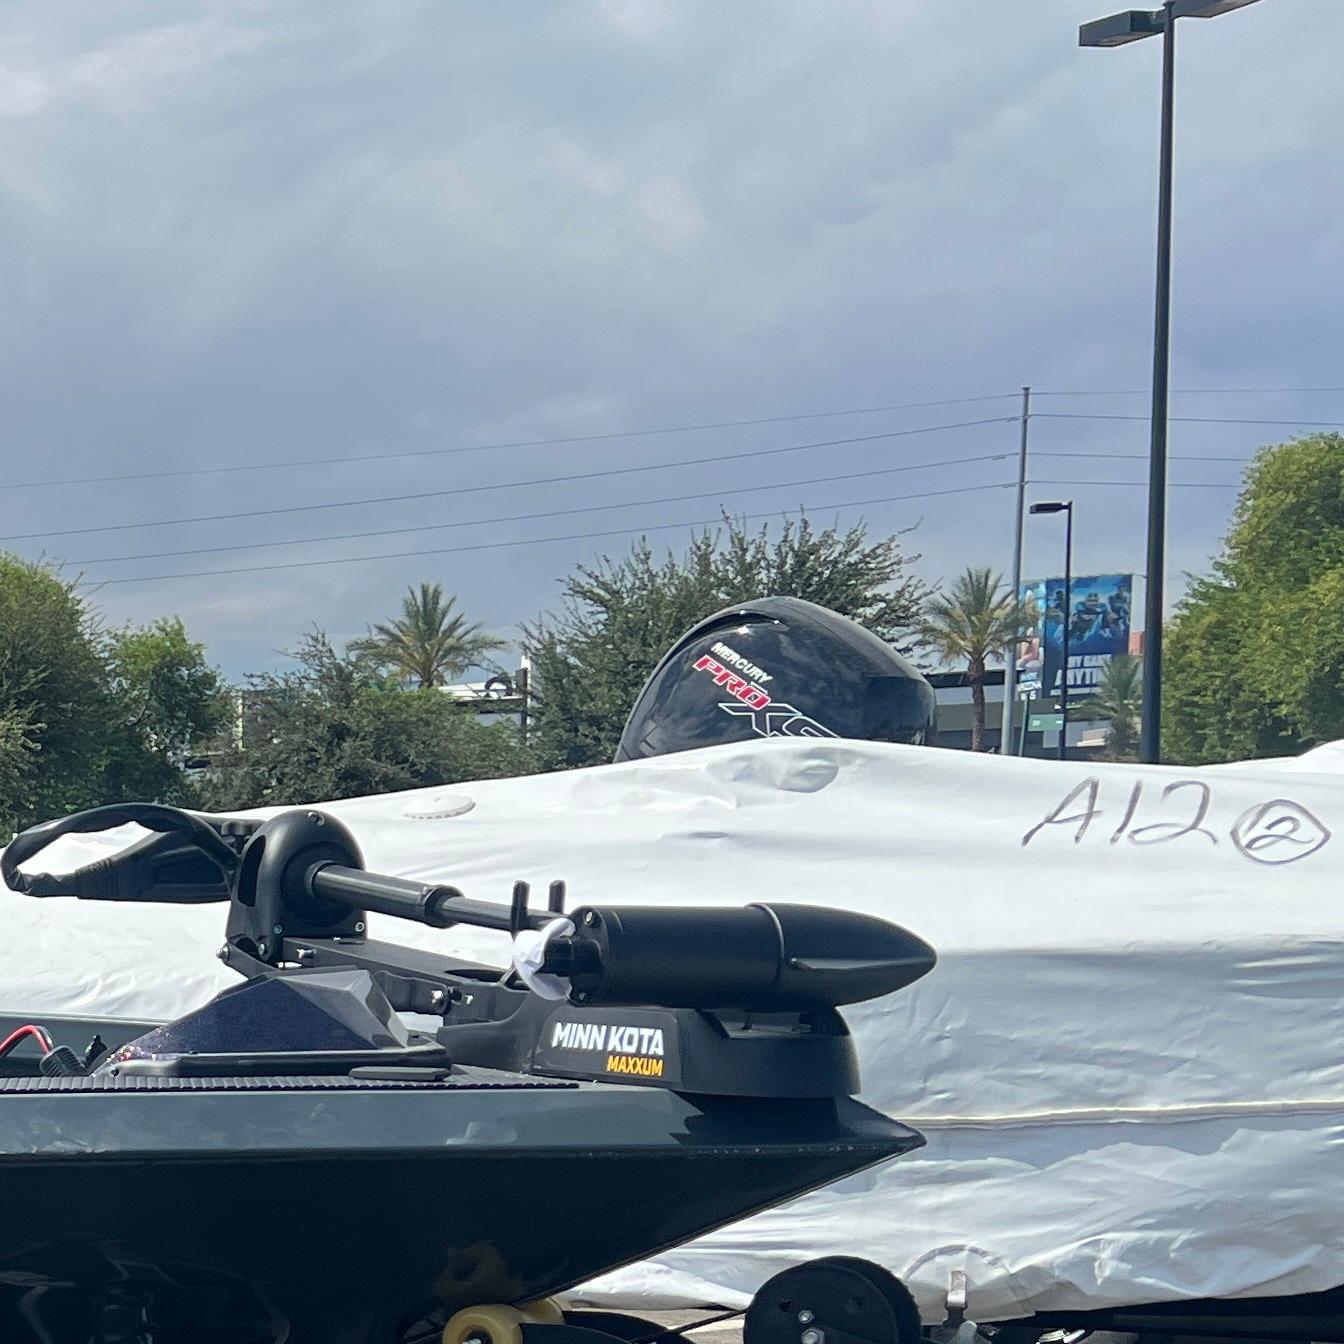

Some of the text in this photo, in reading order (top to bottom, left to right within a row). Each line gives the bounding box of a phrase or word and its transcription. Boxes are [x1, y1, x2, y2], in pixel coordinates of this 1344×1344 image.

[692, 654, 771, 710] PRO
[711, 642, 774, 682] MERCURY
[1021, 776, 1220, 847] A12
[551, 1022, 664, 1056] MINN KOTA
[607, 1055, 663, 1077] MAXXUM
